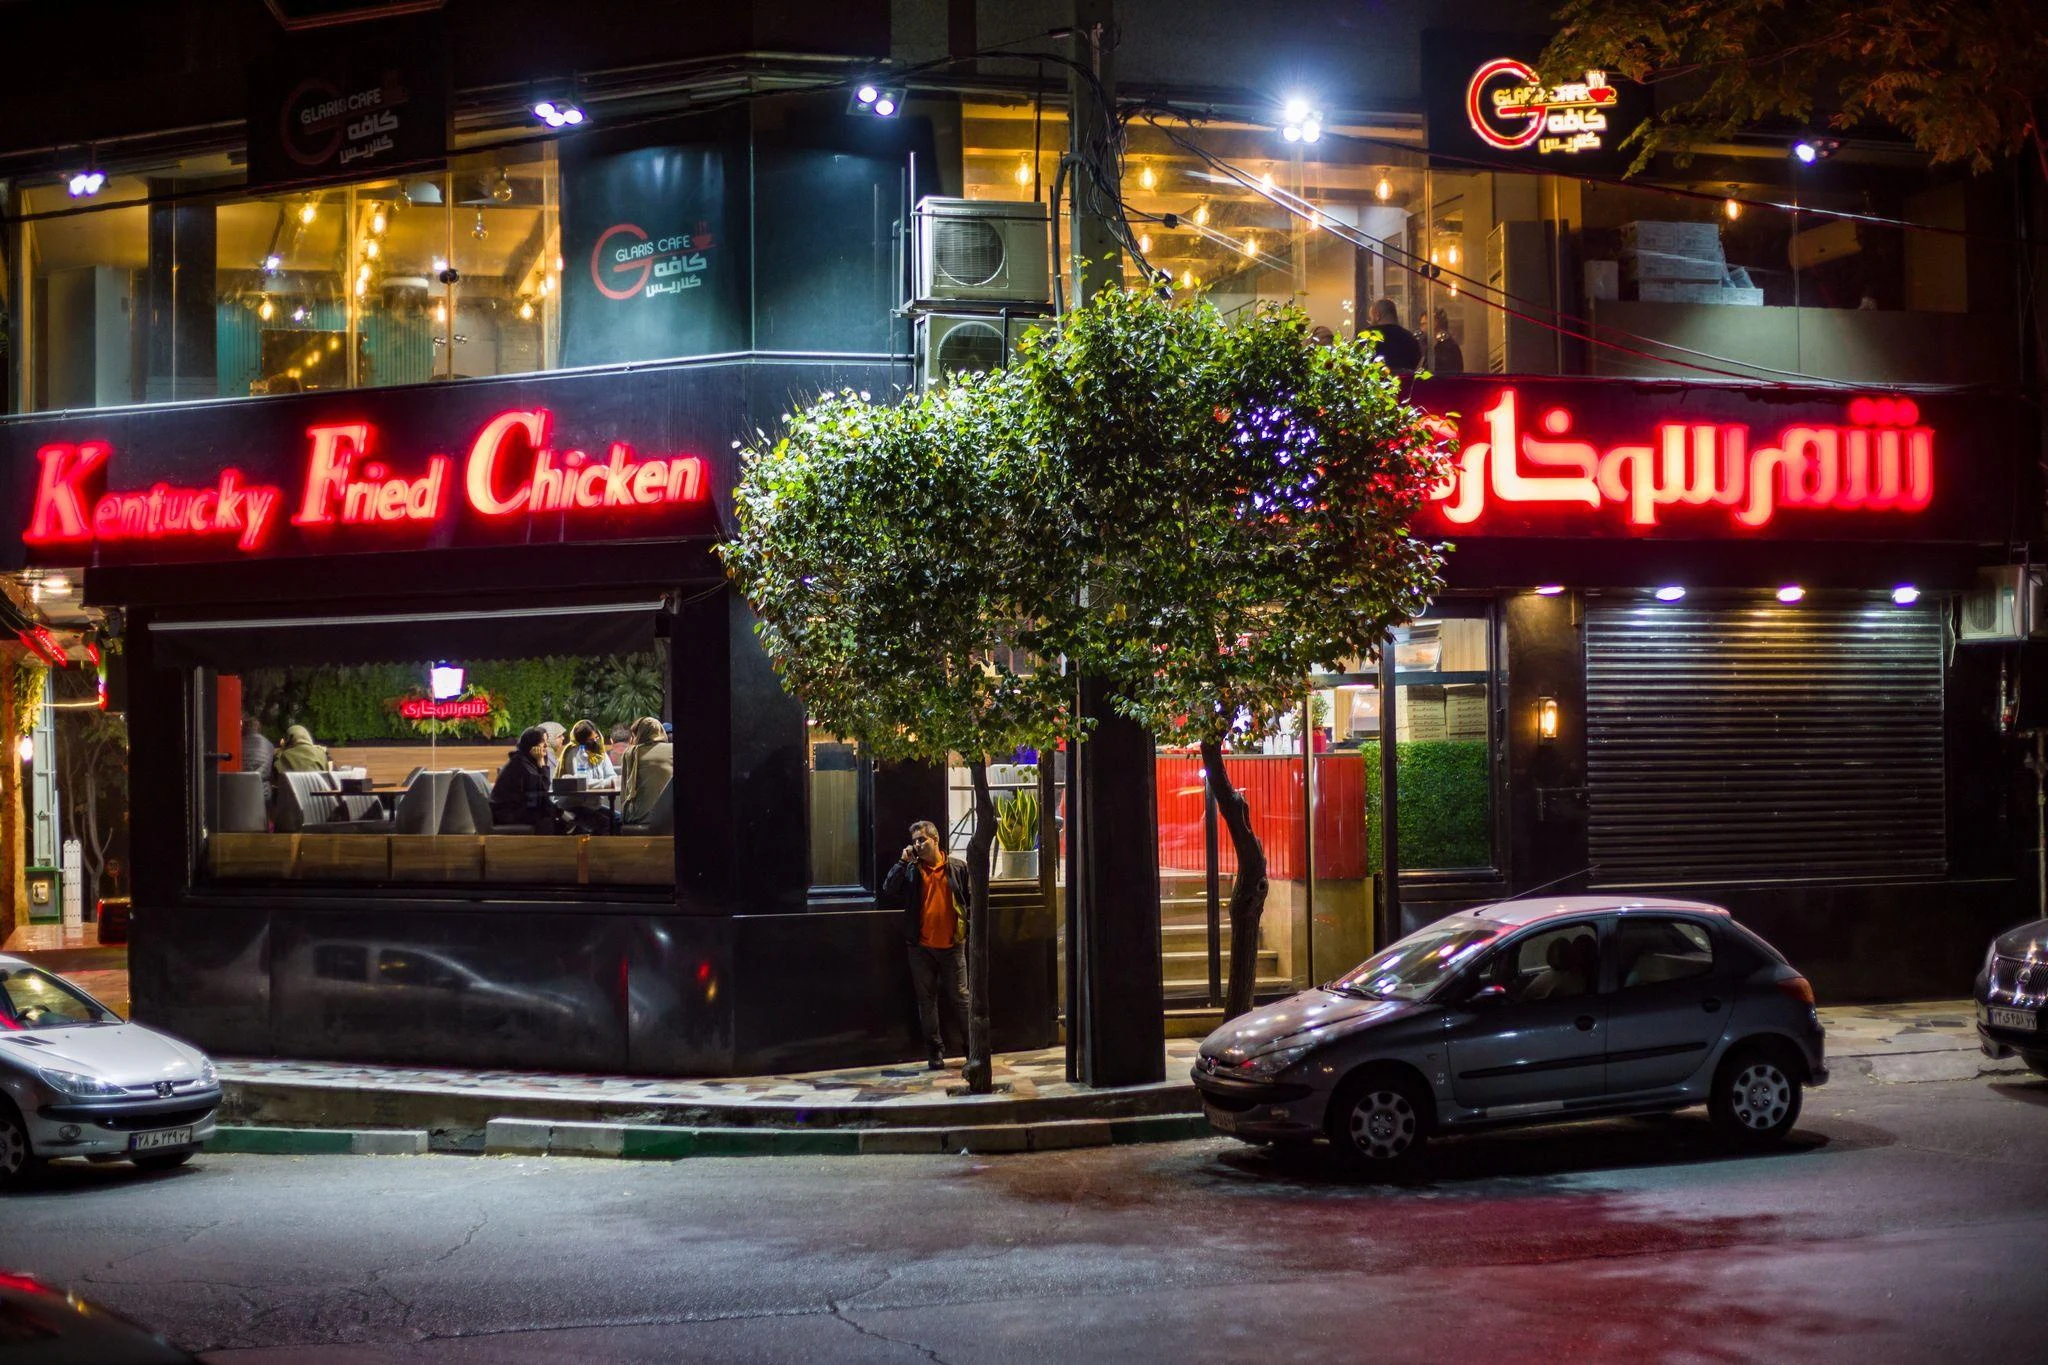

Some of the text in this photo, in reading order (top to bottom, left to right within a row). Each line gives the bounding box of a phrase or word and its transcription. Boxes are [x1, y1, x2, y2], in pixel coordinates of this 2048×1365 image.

[348, 87, 382, 110] CAFE
[1493, 86, 1547, 106] GLAR
[347, 110, 399, 140] کافه
[615, 235, 691, 262] GLARIS CAFE
[654, 253, 707, 277] کافه
[24, 407, 705, 549] Kentucky Fried Chicken
